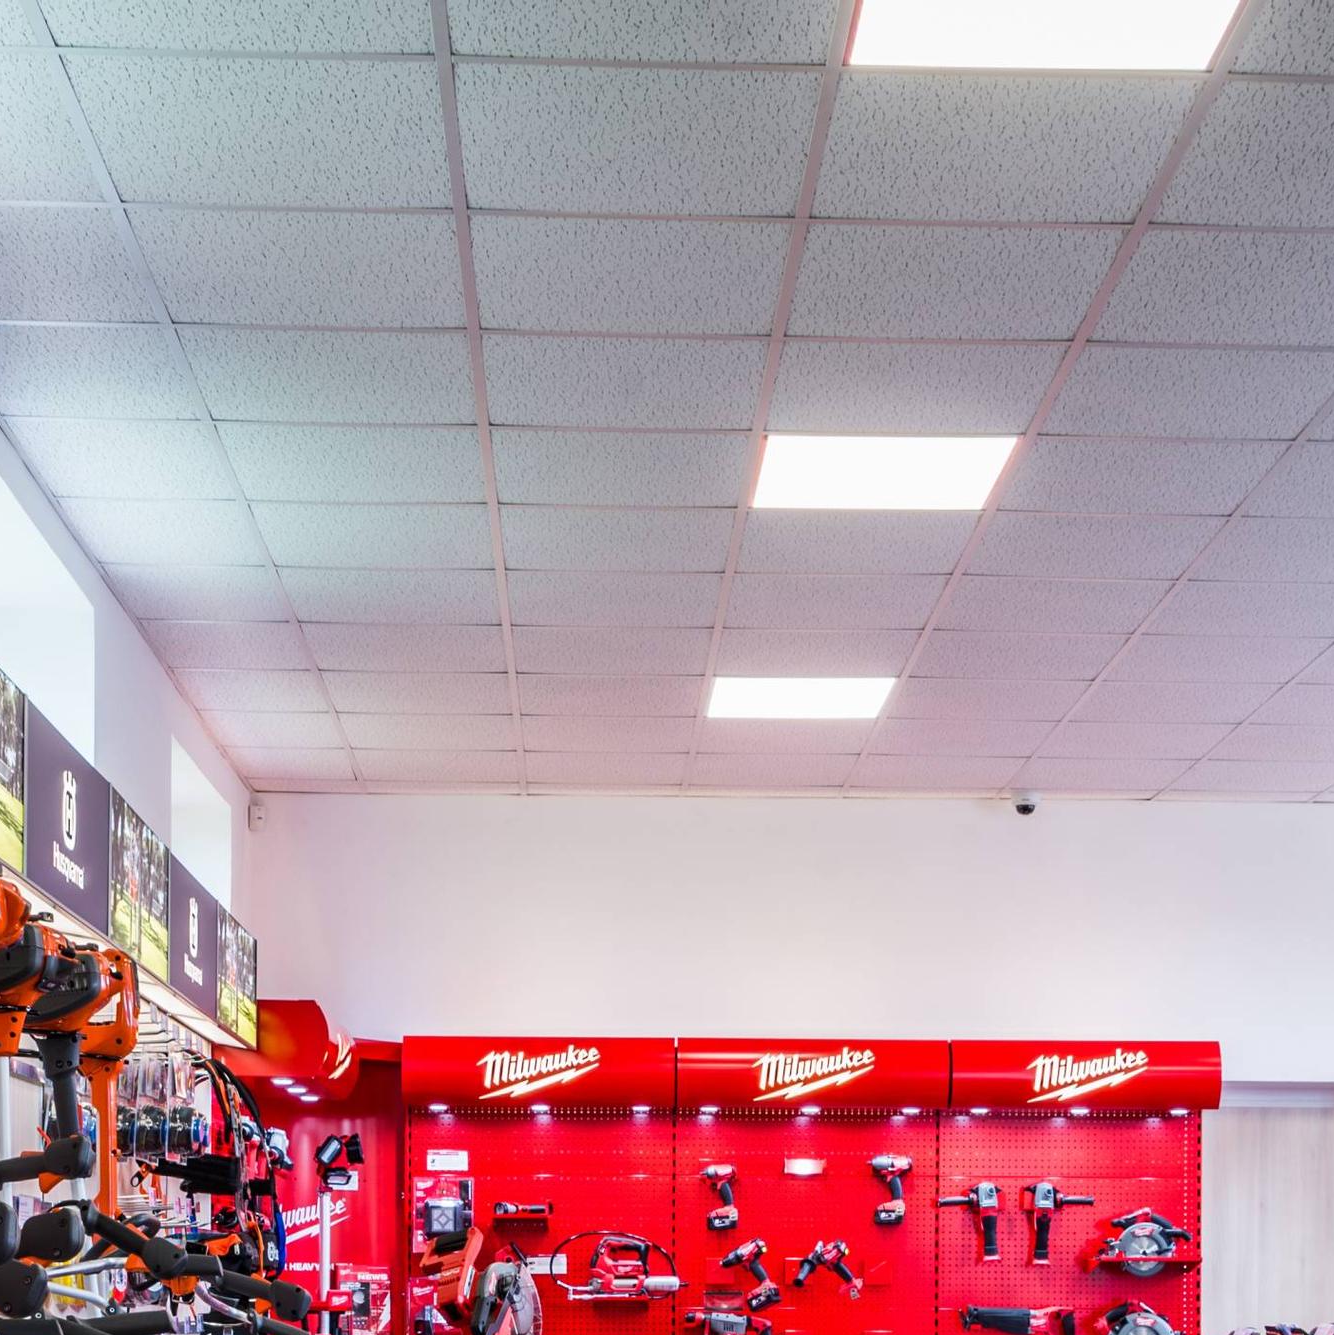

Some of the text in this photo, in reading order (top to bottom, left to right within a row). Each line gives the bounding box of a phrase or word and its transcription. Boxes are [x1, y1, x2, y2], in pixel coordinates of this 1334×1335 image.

[53, 841, 85, 890] Husqvarna
[476, 1044, 601, 1091] Milwaukee
[752, 1046, 876, 1091] Milwaukee
[1027, 1048, 1150, 1092] Milwaukee
